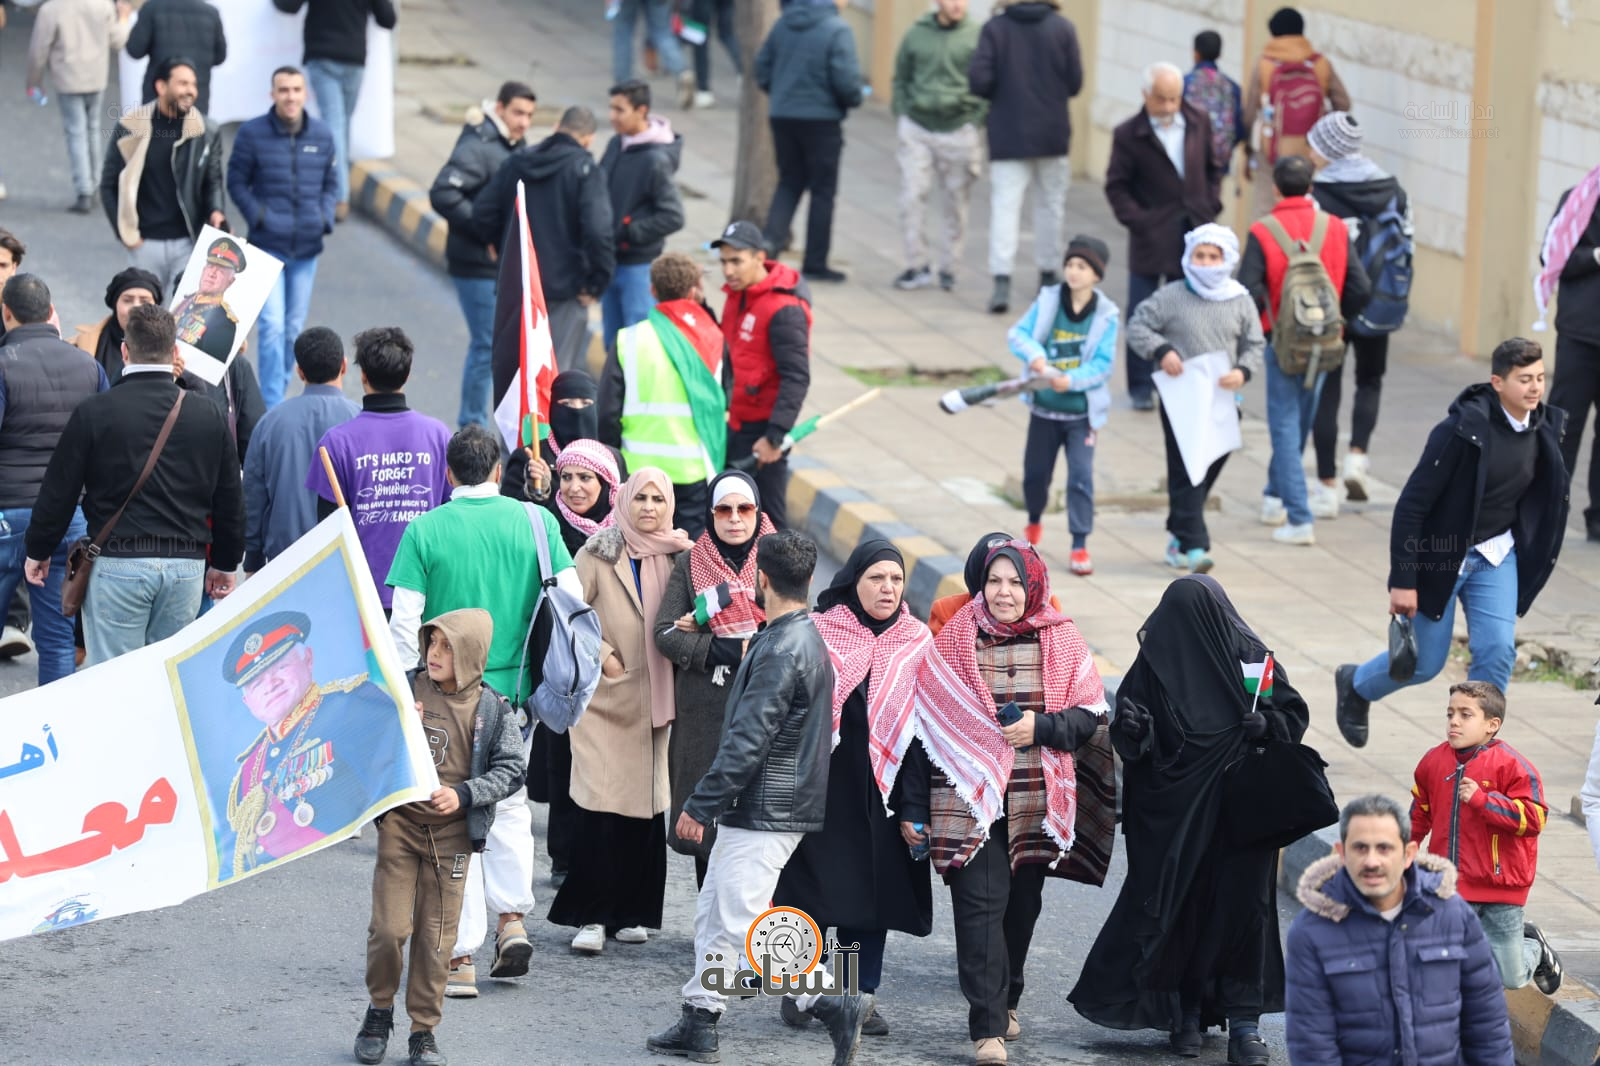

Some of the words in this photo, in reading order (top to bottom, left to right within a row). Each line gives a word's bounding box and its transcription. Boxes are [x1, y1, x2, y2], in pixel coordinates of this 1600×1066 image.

[356, 453, 378, 470] IT'S
[382, 451, 413, 465] HARD
[416, 452, 431, 465] TO
[372, 467, 415, 482] FORGET
[356, 509, 427, 526] REMEMB
